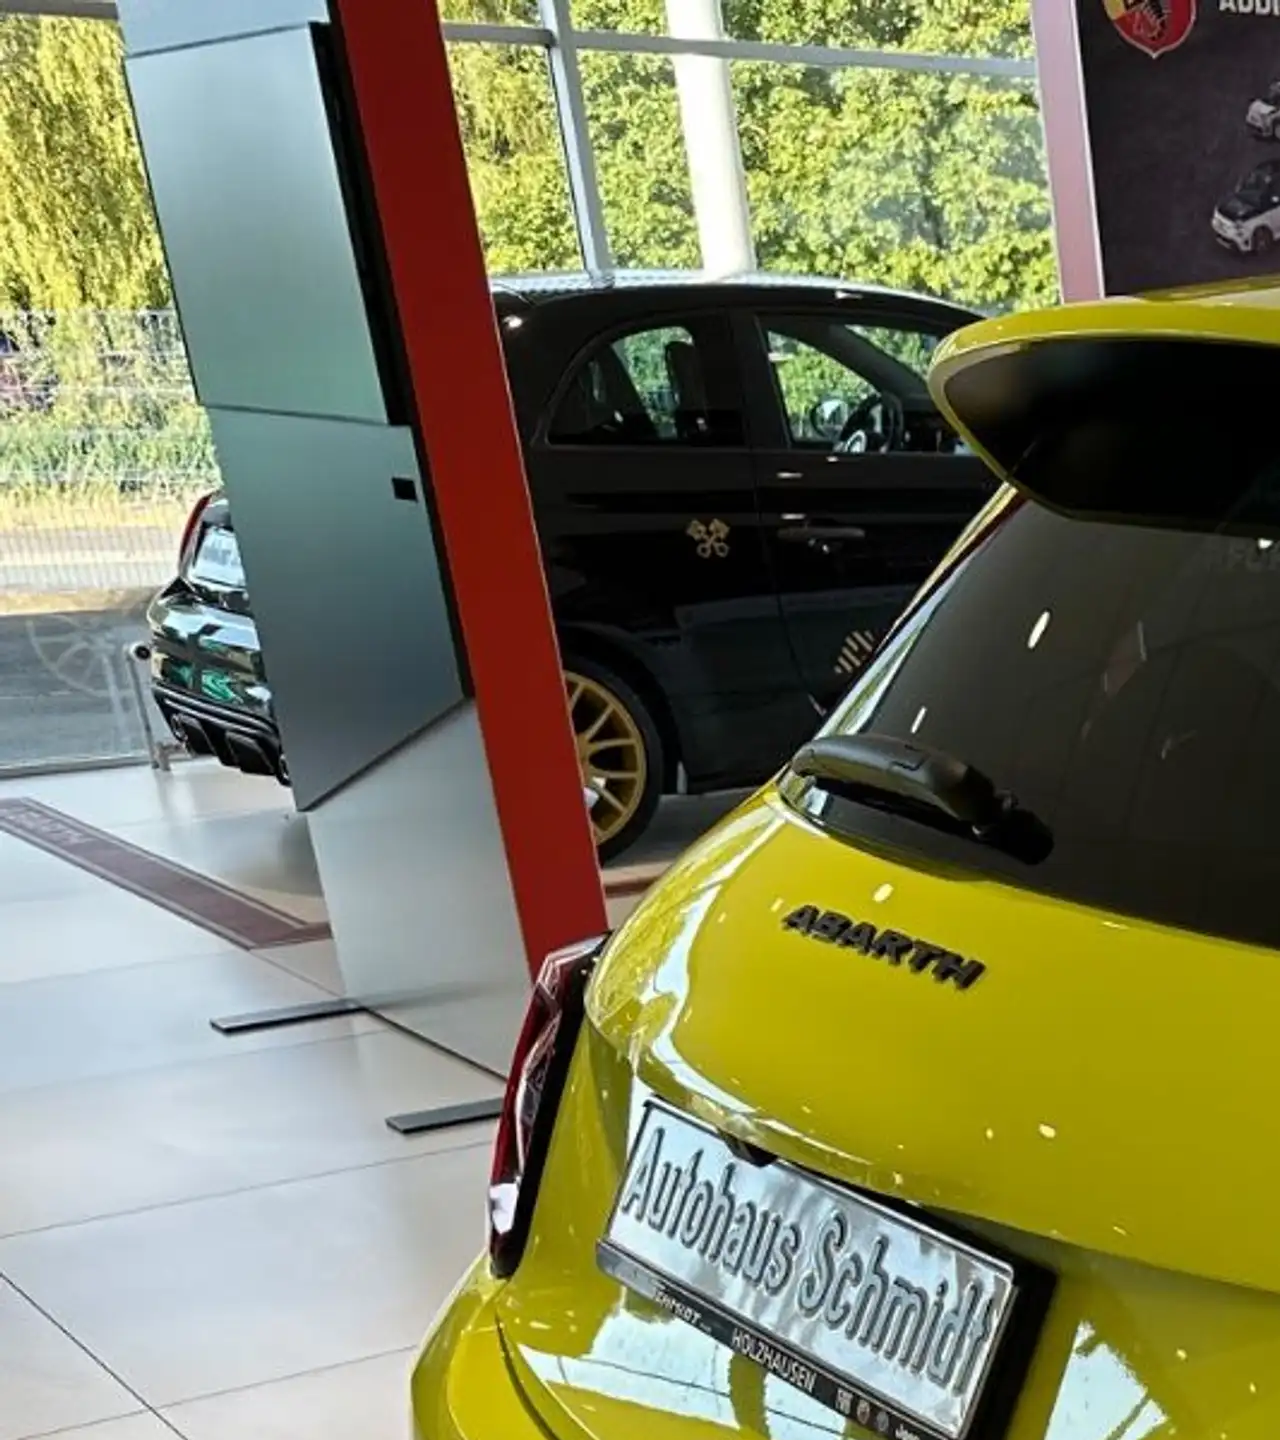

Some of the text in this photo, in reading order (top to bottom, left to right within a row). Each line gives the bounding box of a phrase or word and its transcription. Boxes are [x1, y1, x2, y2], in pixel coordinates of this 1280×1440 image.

[781, 904, 986, 990] ABARTH
[621, 1126, 998, 1396] Autohaus Schmidt
[731, 1327, 818, 1393] HOLZHAUSEN
